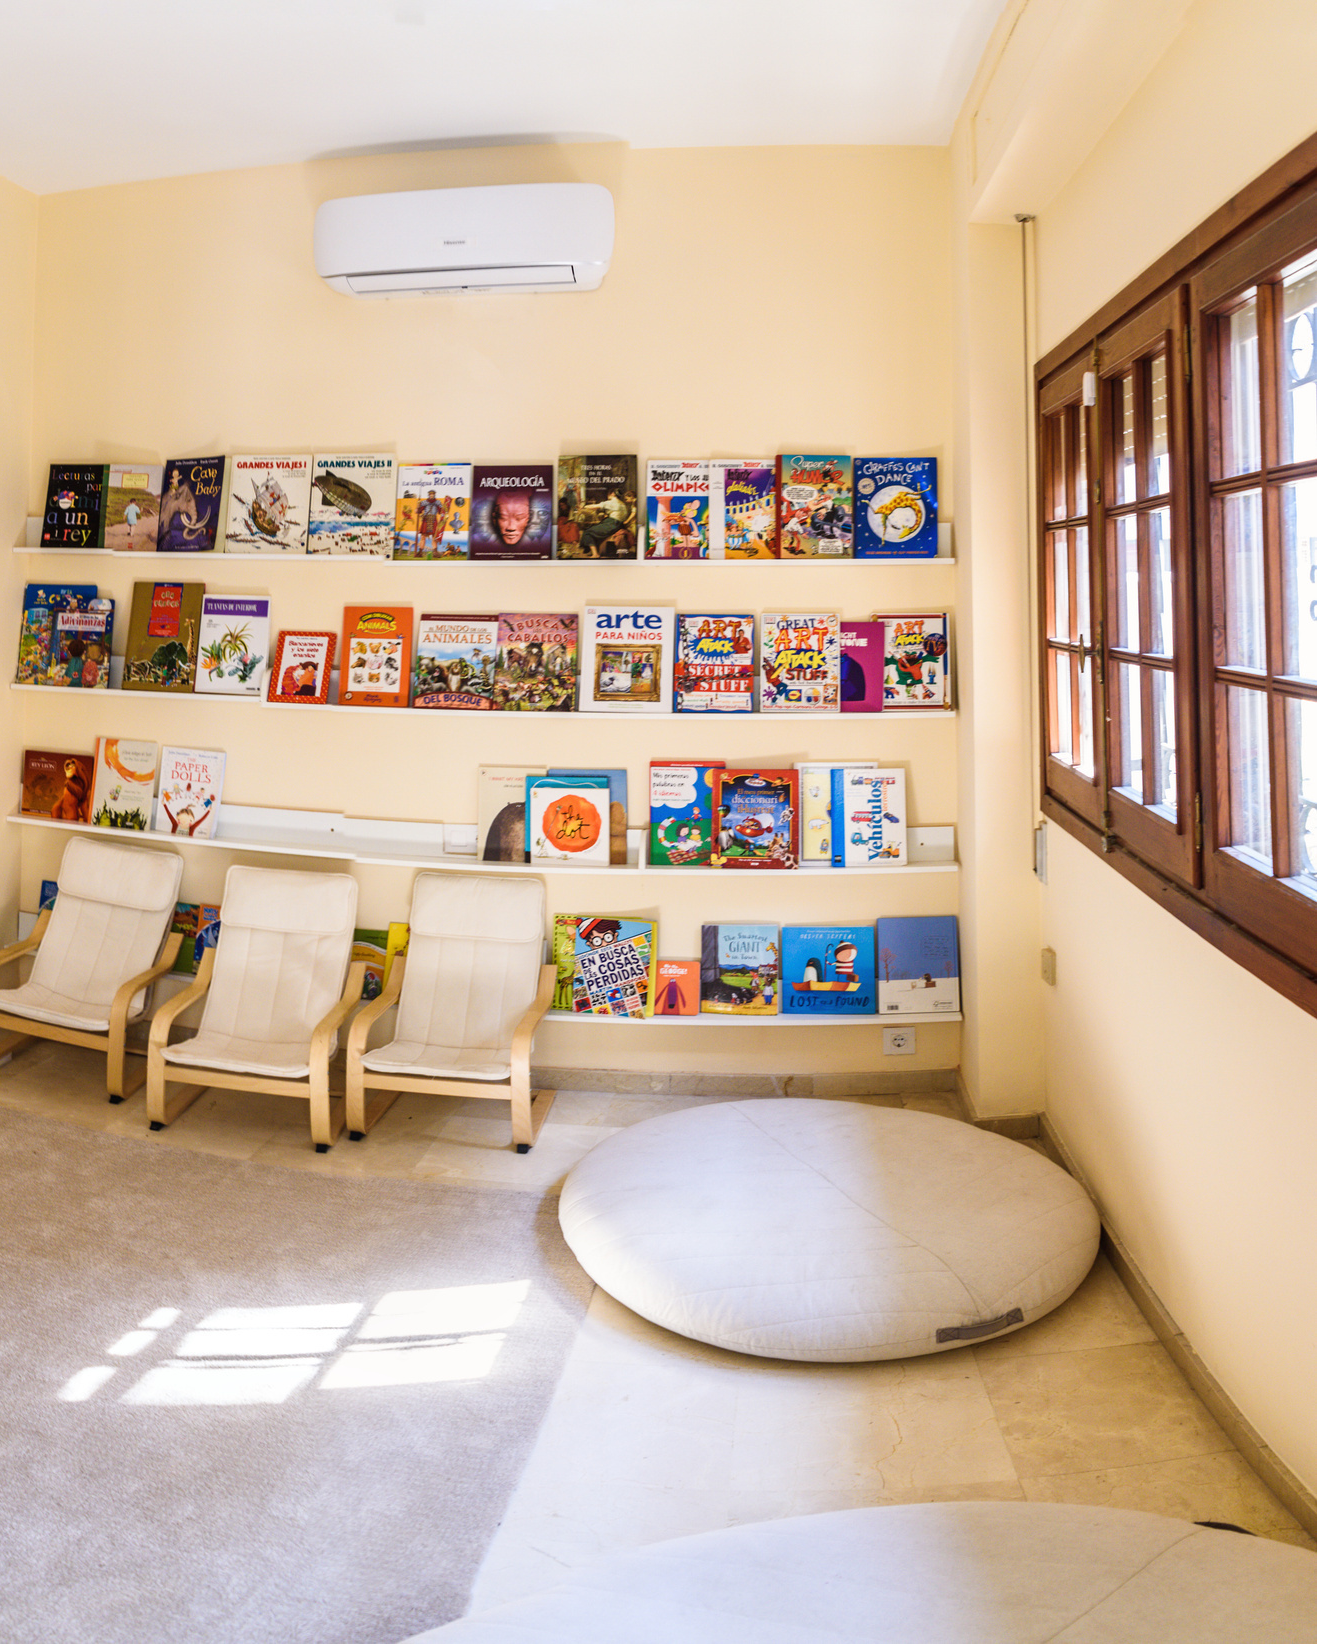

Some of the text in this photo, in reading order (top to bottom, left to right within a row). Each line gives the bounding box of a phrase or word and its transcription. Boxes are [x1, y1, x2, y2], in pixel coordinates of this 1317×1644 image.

[237, 460, 303, 469] GRANDES VIAJES
[317, 460, 386, 468] GRANDES VIAJES
[790, 456, 825, 475] Super
[863, 461, 930, 475] GIRAFFES CAN'T
[190, 466, 218, 482] Cave
[479, 474, 545, 488] ARQUEOLOGÍA
[603, 476, 625, 484] PRADO
[651, 470, 683, 482] Asterix
[791, 468, 845, 486] HUMOR
[875, 474, 913, 486] DANCE
[433, 476, 465, 487] ROMA
[195, 480, 221, 498] Baby
[65, 511, 89, 526] un
[63, 528, 91, 546] rey
[61, 614, 107, 628] Adivinanzas
[357, 621, 397, 632] ANIMALS
[517, 618, 559, 632] BUSCA
[595, 610, 663, 629] arte
[777, 618, 817, 630] GREAT
[595, 630, 663, 640] PARA NIÑOS
[697, 619, 742, 640] ART
[893, 620, 925, 636] ART
[423, 633, 491, 644] ANIMALES
[507, 632, 569, 644] CABALLOS
[774, 627, 829, 652] ART
[895, 634, 924, 646] ATTACK
[696, 638, 734, 654] ATTACK
[774, 650, 827, 669] ATTACK
[689, 665, 742, 676] SECRET
[785, 668, 829, 681] STUFF
[699, 680, 749, 692] STUFF
[423, 694, 483, 706] DEL BOSQUE
[175, 761, 209, 774] PAPER
[171, 770, 211, 784] DOLLS
[731, 794, 778, 804] diccionari
[561, 804, 584, 821] the
[867, 780, 883, 861] Vehículos
[557, 820, 591, 840] dot
[737, 932, 768, 943] Smartest
[728, 940, 763, 954] GIANT
[581, 944, 636, 969] EN BUSCA
[598, 954, 640, 975] COSAS
[587, 964, 645, 992] PERDIDAS
[789, 994, 871, 1008] LOST FOUND
